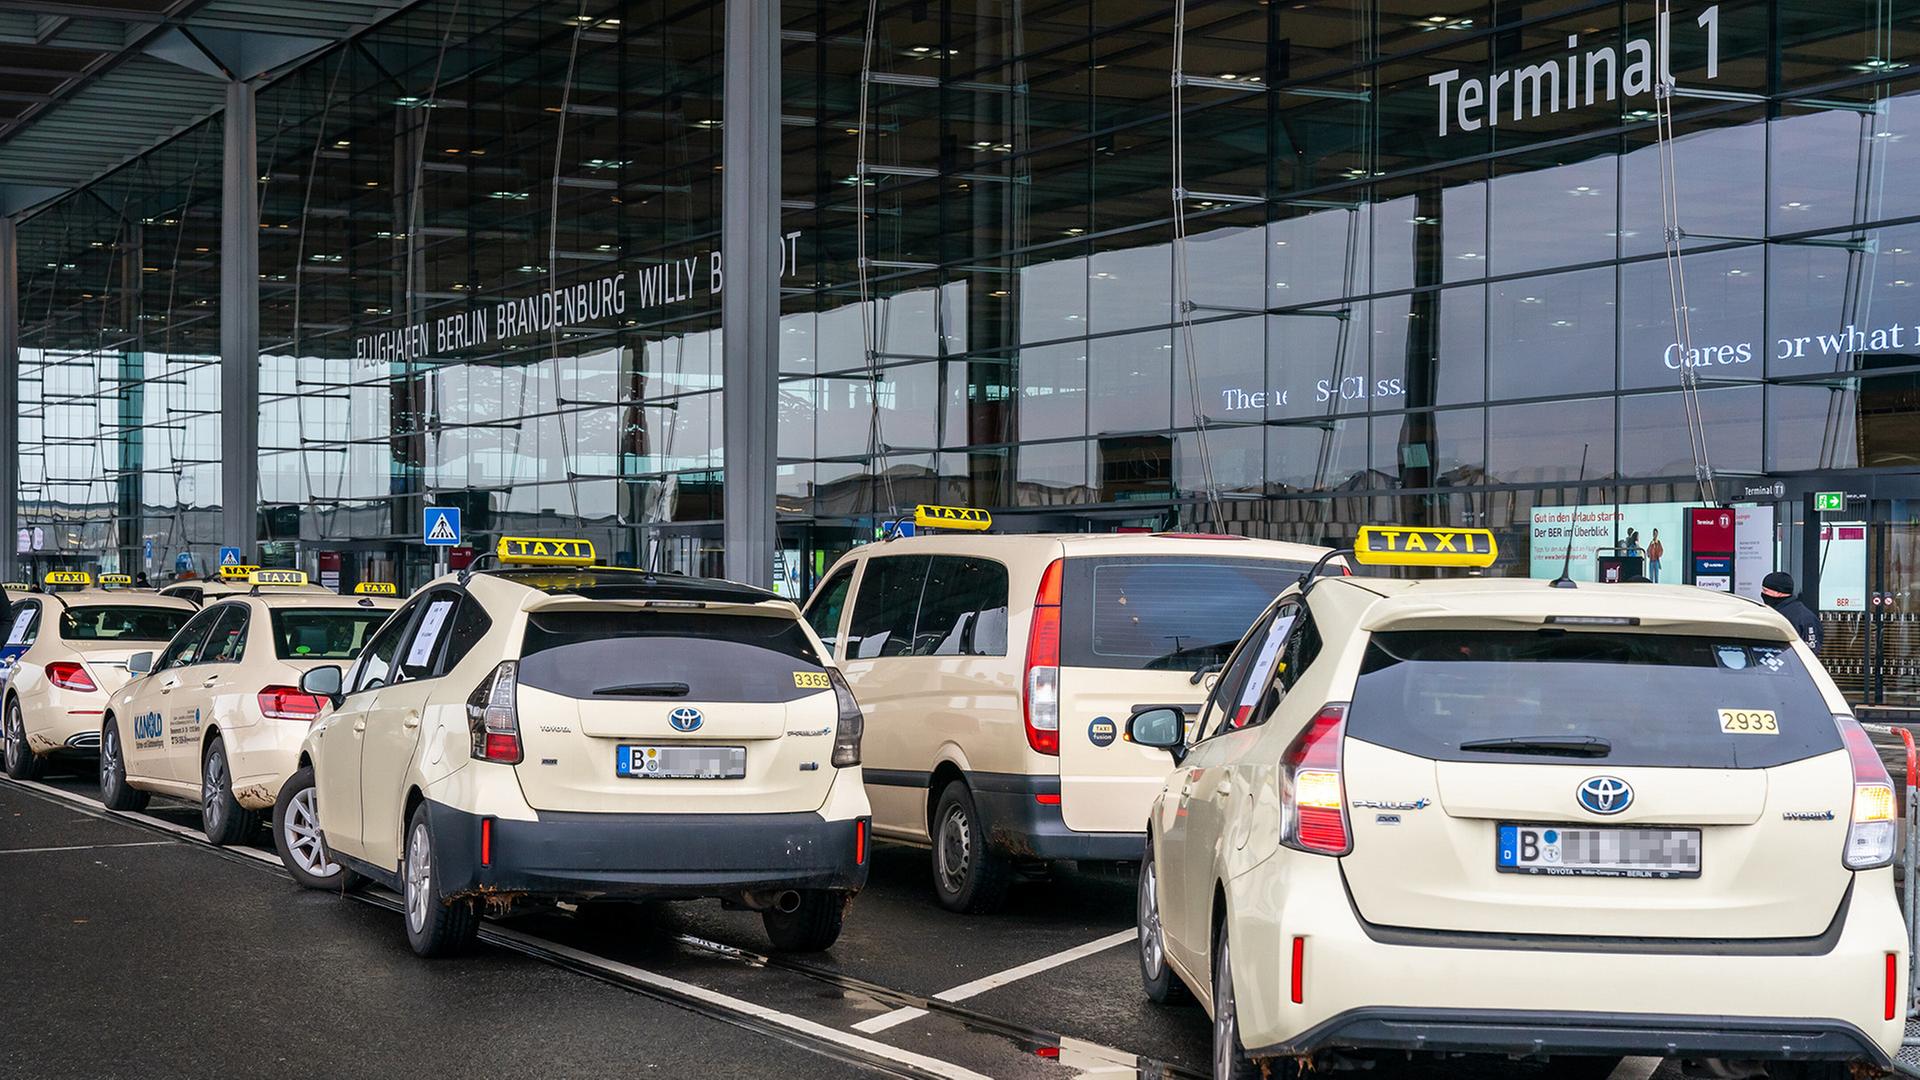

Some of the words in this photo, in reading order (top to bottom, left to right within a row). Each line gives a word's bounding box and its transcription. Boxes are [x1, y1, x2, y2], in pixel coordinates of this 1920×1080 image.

[1428, 11, 1676, 137] Terminal
[1697, 5, 1719, 79] 1
[357, 322, 429, 370] FLUGHAFEN
[437, 307, 487, 353] BERLIN
[497, 273, 625, 340] BRANDENBURG
[638, 256, 698, 309] WILLY
[1664, 341, 1751, 370] Cares
[1816, 322, 1904, 355] what
[1744, 485, 1773, 496] Terminal
[1774, 485, 1784, 494] T1
[929, 506, 982, 520] TAXI
[1534, 513, 1547, 523] Gut
[1548, 512, 1556, 522] in
[1557, 511, 1570, 522] den
[1572, 511, 1596, 522] Urlaub
[1720, 516, 1729, 526] T1
[1534, 528, 1547, 538] Der
[1548, 527, 1562, 537] BER
[1564, 526, 1572, 537] im
[1574, 525, 1609, 537] Überblick
[515, 540, 582, 557] TAXI
[1381, 532, 1474, 553] TAXI
[55, 573, 85, 583] TAXI
[263, 572, 297, 583] TAXI
[365, 583, 392, 593] TAXI
[1836, 598, 1849, 606] BER
[795, 673, 830, 687] 3369
[1722, 712, 1776, 730] 2933
[540, 725, 571, 733] TOYOTA
[631, 749, 645, 770] B
[1520, 830, 1540, 862] B
[1504, 850, 1511, 859] D
[1546, 867, 1575, 875] TOYOTA
[1627, 870, 1652, 878] BERLIN
